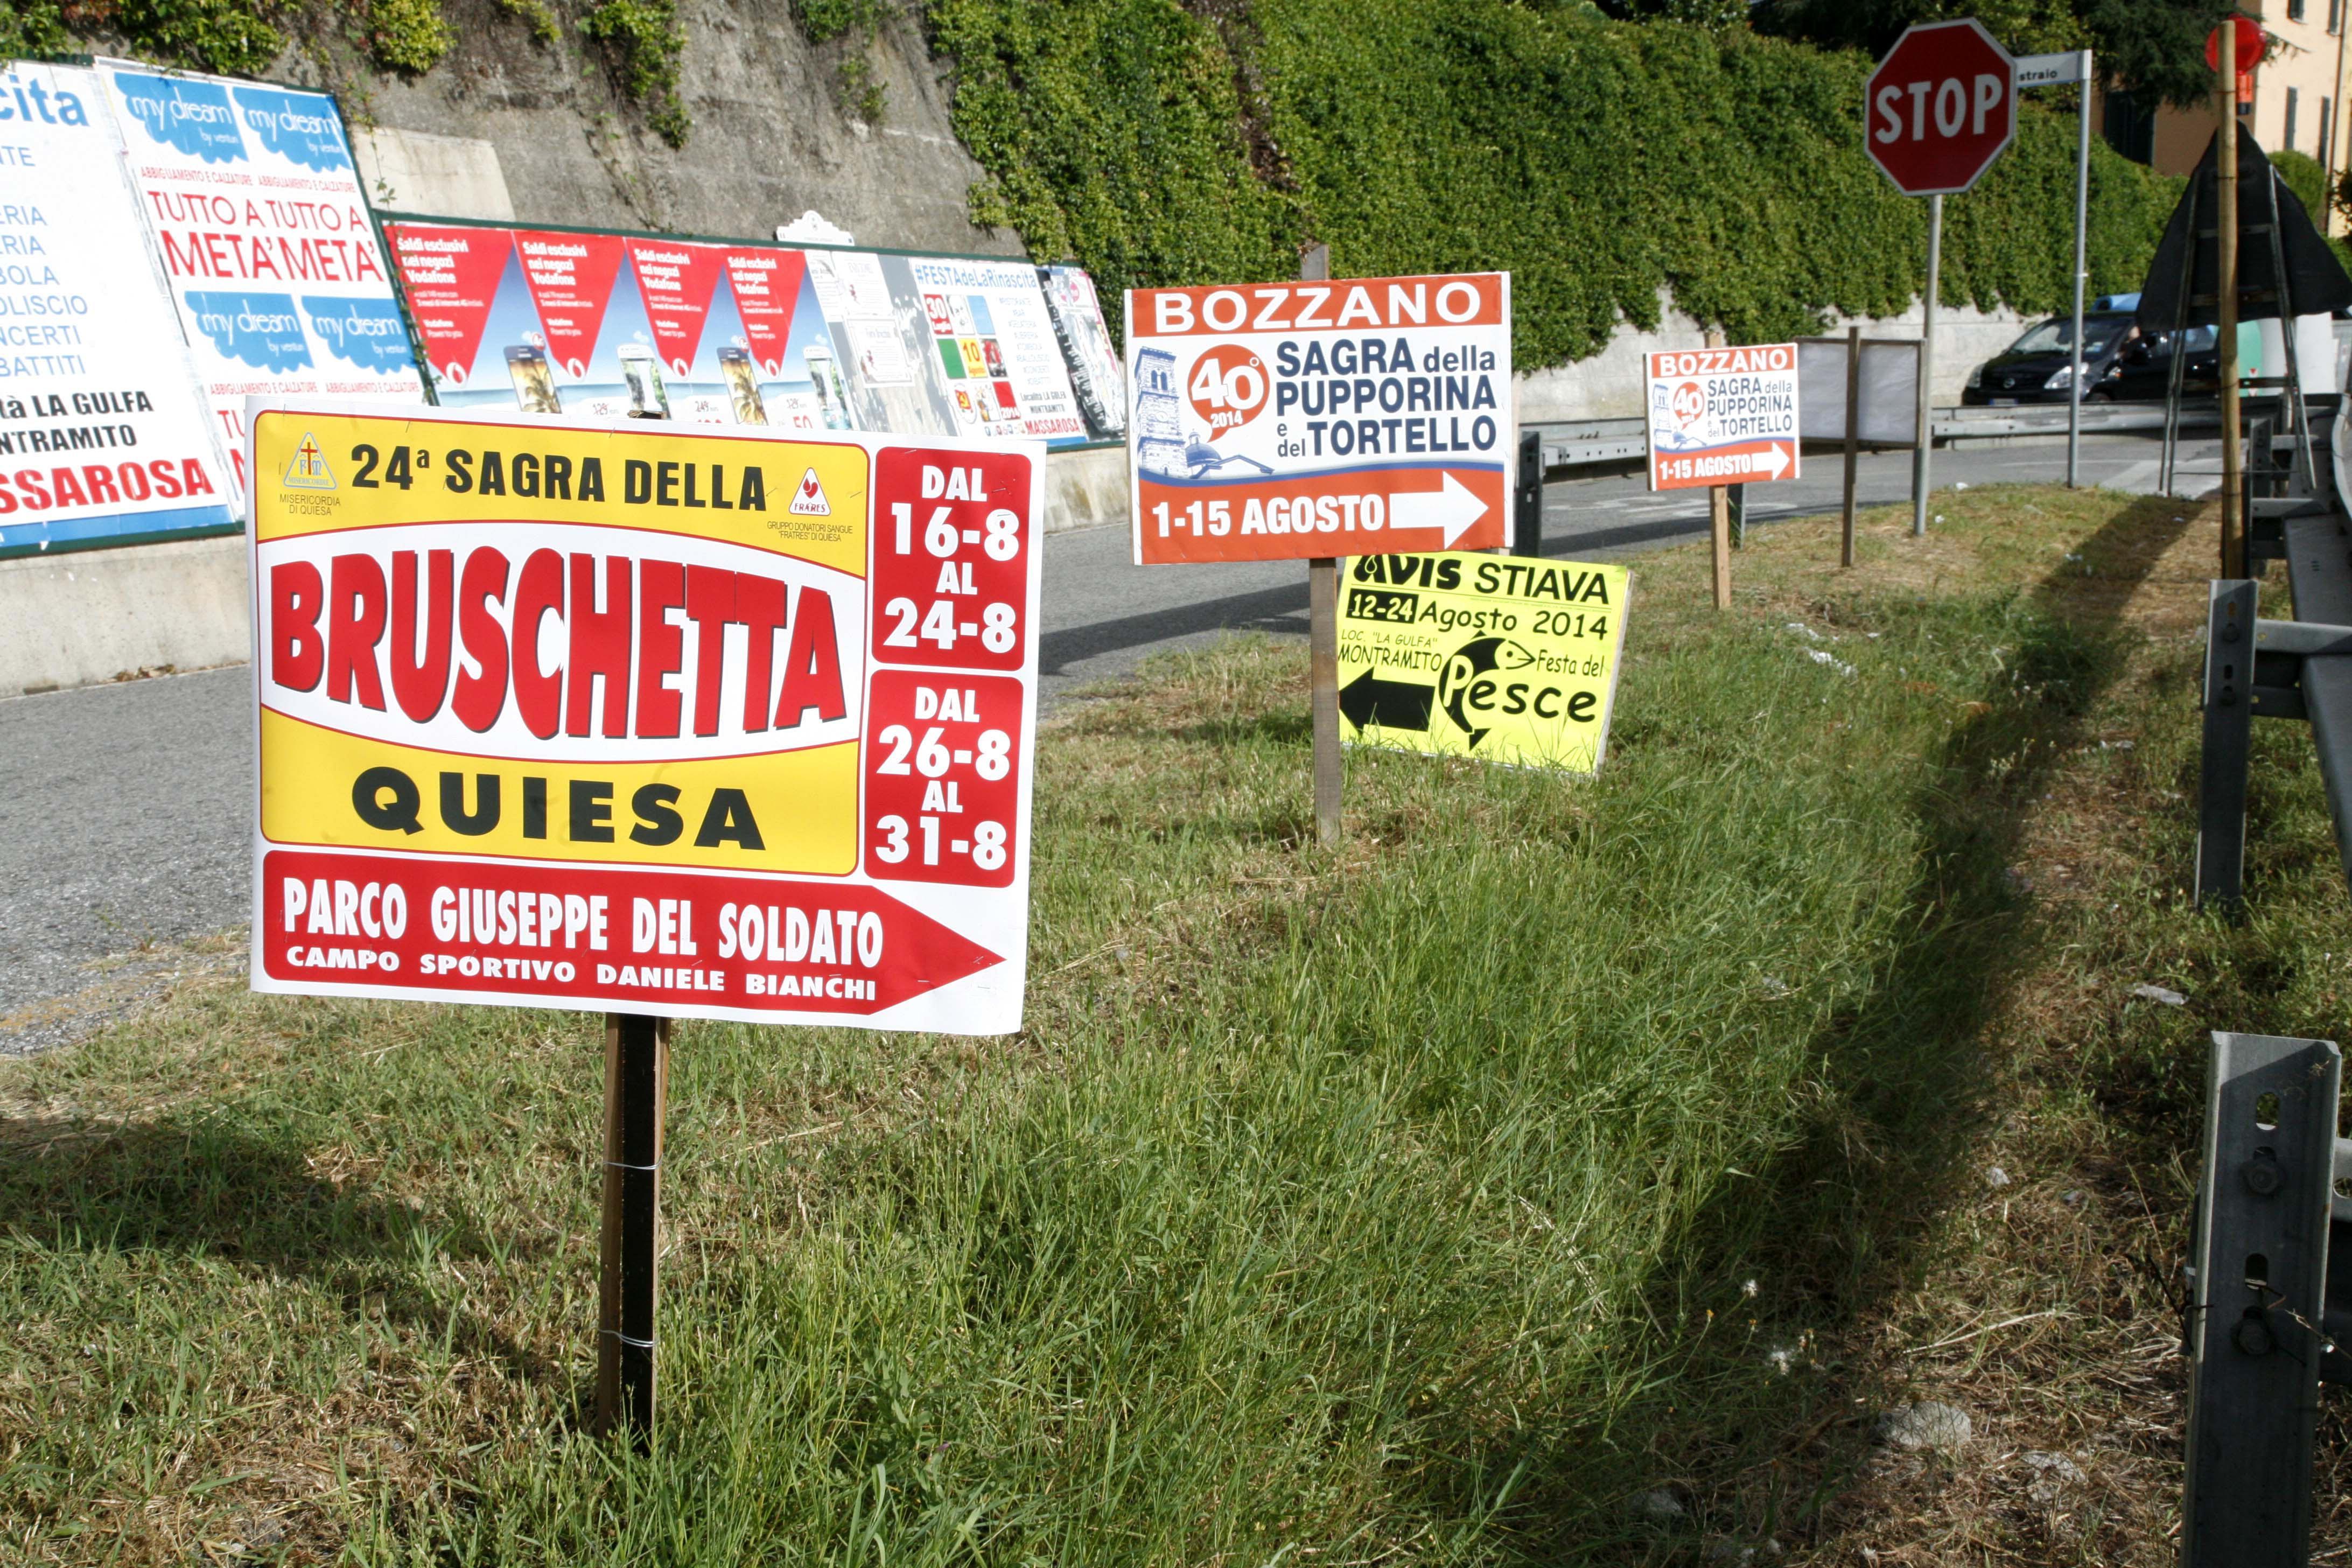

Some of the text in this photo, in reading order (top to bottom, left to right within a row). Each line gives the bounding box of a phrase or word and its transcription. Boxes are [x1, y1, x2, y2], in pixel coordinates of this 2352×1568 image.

[131, 86, 233, 131] my dream
[248, 99, 338, 142] my dream
[1875, 74, 2003, 144] STOP
[147, 191, 368, 232] TUTTO A TUTTO A
[0, 235, 46, 255] RIA
[160, 230, 384, 282] META' META'
[397, 237, 469, 253] Saldi esclusivi
[522, 241, 587, 257] Saldi esclusivi
[634, 248, 691, 265] Saldi esclusivi
[405, 269, 457, 284] Vodafone
[421, 254, 455, 271] negozi
[527, 257, 575, 273] nei negozi
[639, 263, 680, 279] nei negozi
[727, 256, 777, 269] Saldi esclusivi
[915, 264, 1038, 289] #FESTAdeLaRinascita
[530, 271, 576, 286] Vodafone
[642, 276, 682, 291] Vodafone
[735, 283, 770, 295] Vodafone
[925, 297, 948, 320] 30
[1154, 281, 1481, 333] BOZZANO
[201, 299, 299, 346] my dream
[317, 304, 402, 348] my dream
[962, 342, 981, 362] 10
[1276, 337, 1496, 378] SAGRA della
[1659, 348, 1788, 377] BOZZANO
[1276, 374, 1497, 417] PUPPORINA
[1707, 377, 1793, 397] SAGRA della
[31, 395, 68, 417] LA
[72, 391, 154, 415] GULFA
[1707, 394, 1793, 417] PUPPORINA
[1024, 418, 1081, 435] MASSAROSA
[1210, 411, 1244, 429] 2014
[1277, 422, 1289, 437] e
[1719, 414, 1793, 437] TORTELLO
[1277, 415, 1497, 458] del TORTELLO
[445, 449, 605, 503] SAGRA
[624, 459, 767, 512] DELLA
[1660, 453, 1752, 480] 1-15 AGOSTO
[921, 465, 988, 502] DAL
[279, 493, 341, 507] MISERICORDIA
[289, 505, 332, 516] DI QUIESA
[767, 521, 853, 534] GRUPPO DONATORI SANGUE
[1152, 493, 1385, 538] 1-15 AGOSTO
[811, 532, 818, 541] DI
[818, 533, 842, 542] QUIESA
[891, 502, 1019, 562] 16-8
[935, 561, 978, 595] AL
[1353, 554, 1610, 605] AVIS STIAVA
[883, 597, 1016, 654] 24-8
[1351, 593, 1413, 621] 12-24
[1418, 600, 1517, 633] Agosto
[1532, 610, 1608, 641] 2014
[271, 545, 848, 740] BRUSCHETTA
[1341, 629, 1366, 642] LOC.
[1338, 643, 1443, 672] MONTRAMITO
[1536, 648, 1606, 678] Festa del
[1443, 654, 1598, 723] Pesce
[914, 687, 980, 723] DAL
[876, 724, 1011, 781] 26-8
[352, 766, 766, 851] QUIESA
[921, 780, 963, 813] AL
[875, 814, 1007, 871] 31-8
[284, 877, 884, 968] PARCO GIUSEPPE DEL SOLDATO
[286, 946, 876, 1001] CAMPO SPORTIVO DANIELE BIANCHI
